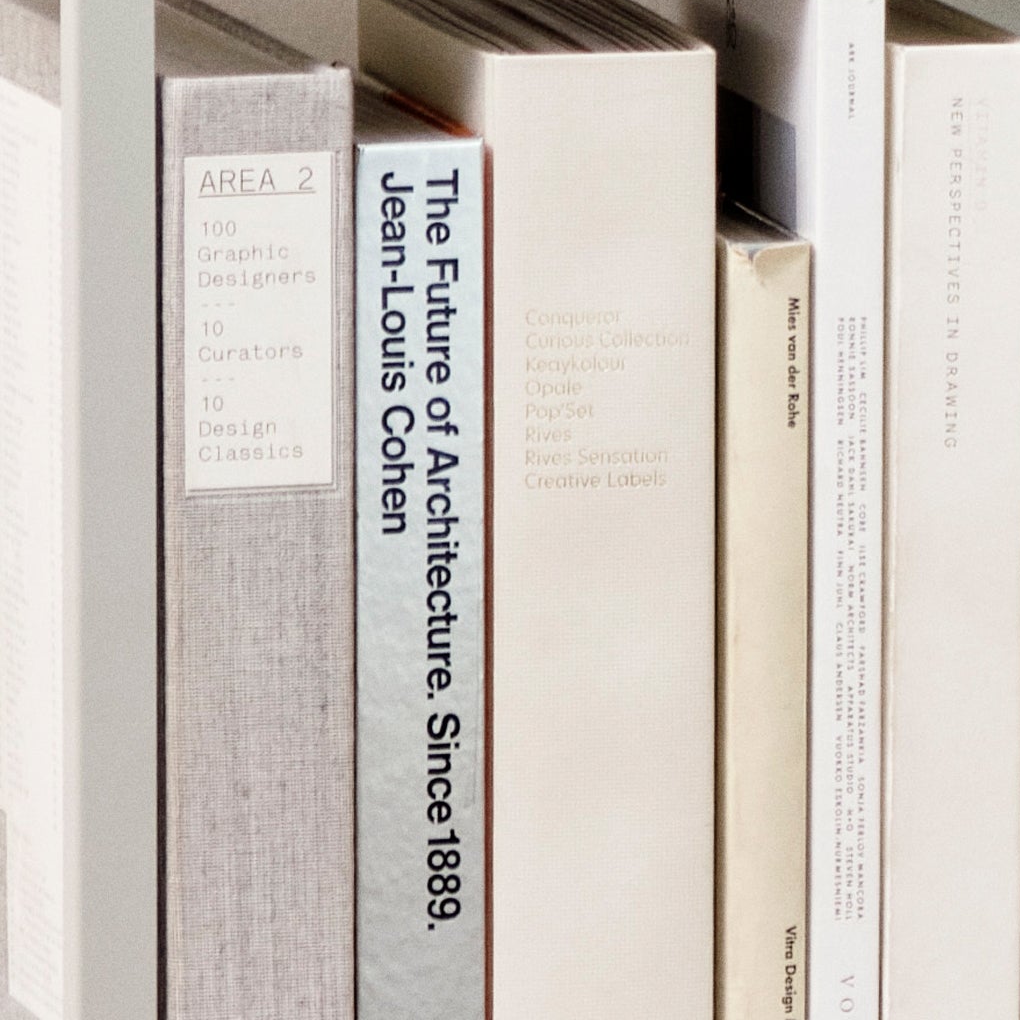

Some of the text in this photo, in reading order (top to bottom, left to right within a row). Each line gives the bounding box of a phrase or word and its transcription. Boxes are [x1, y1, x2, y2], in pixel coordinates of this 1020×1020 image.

[200, 166, 313, 193] AREA 2
[203, 220, 236, 237] 100
[198, 244, 288, 264] Graphic
[199, 270, 316, 289] Designers
[944, 98, 963, 448] NEW PERSPECTIVES IN DRAWING
[525, 309, 619, 328] Conqueror
[204, 321, 223, 337] 10
[525, 332, 689, 349] Curious Collection
[199, 345, 303, 362] Curators
[381, 172, 415, 534] Jean-Louis Cohen
[526, 355, 624, 375] Keaykolour
[788, 298, 800, 428] Mies van der Rohe
[525, 380, 582, 398] Opale
[203, 396, 223, 412] 10
[199, 420, 276, 439] Design
[526, 427, 571, 442] Rives
[199, 443, 303, 462] Classics
[525, 448, 667, 465] Rives Sensation
[525, 471, 666, 489] Creative Labels
[426, 169, 461, 930] The Future of Architecture. Since 1889.
[782, 926, 797, 1013] Vitra Design
